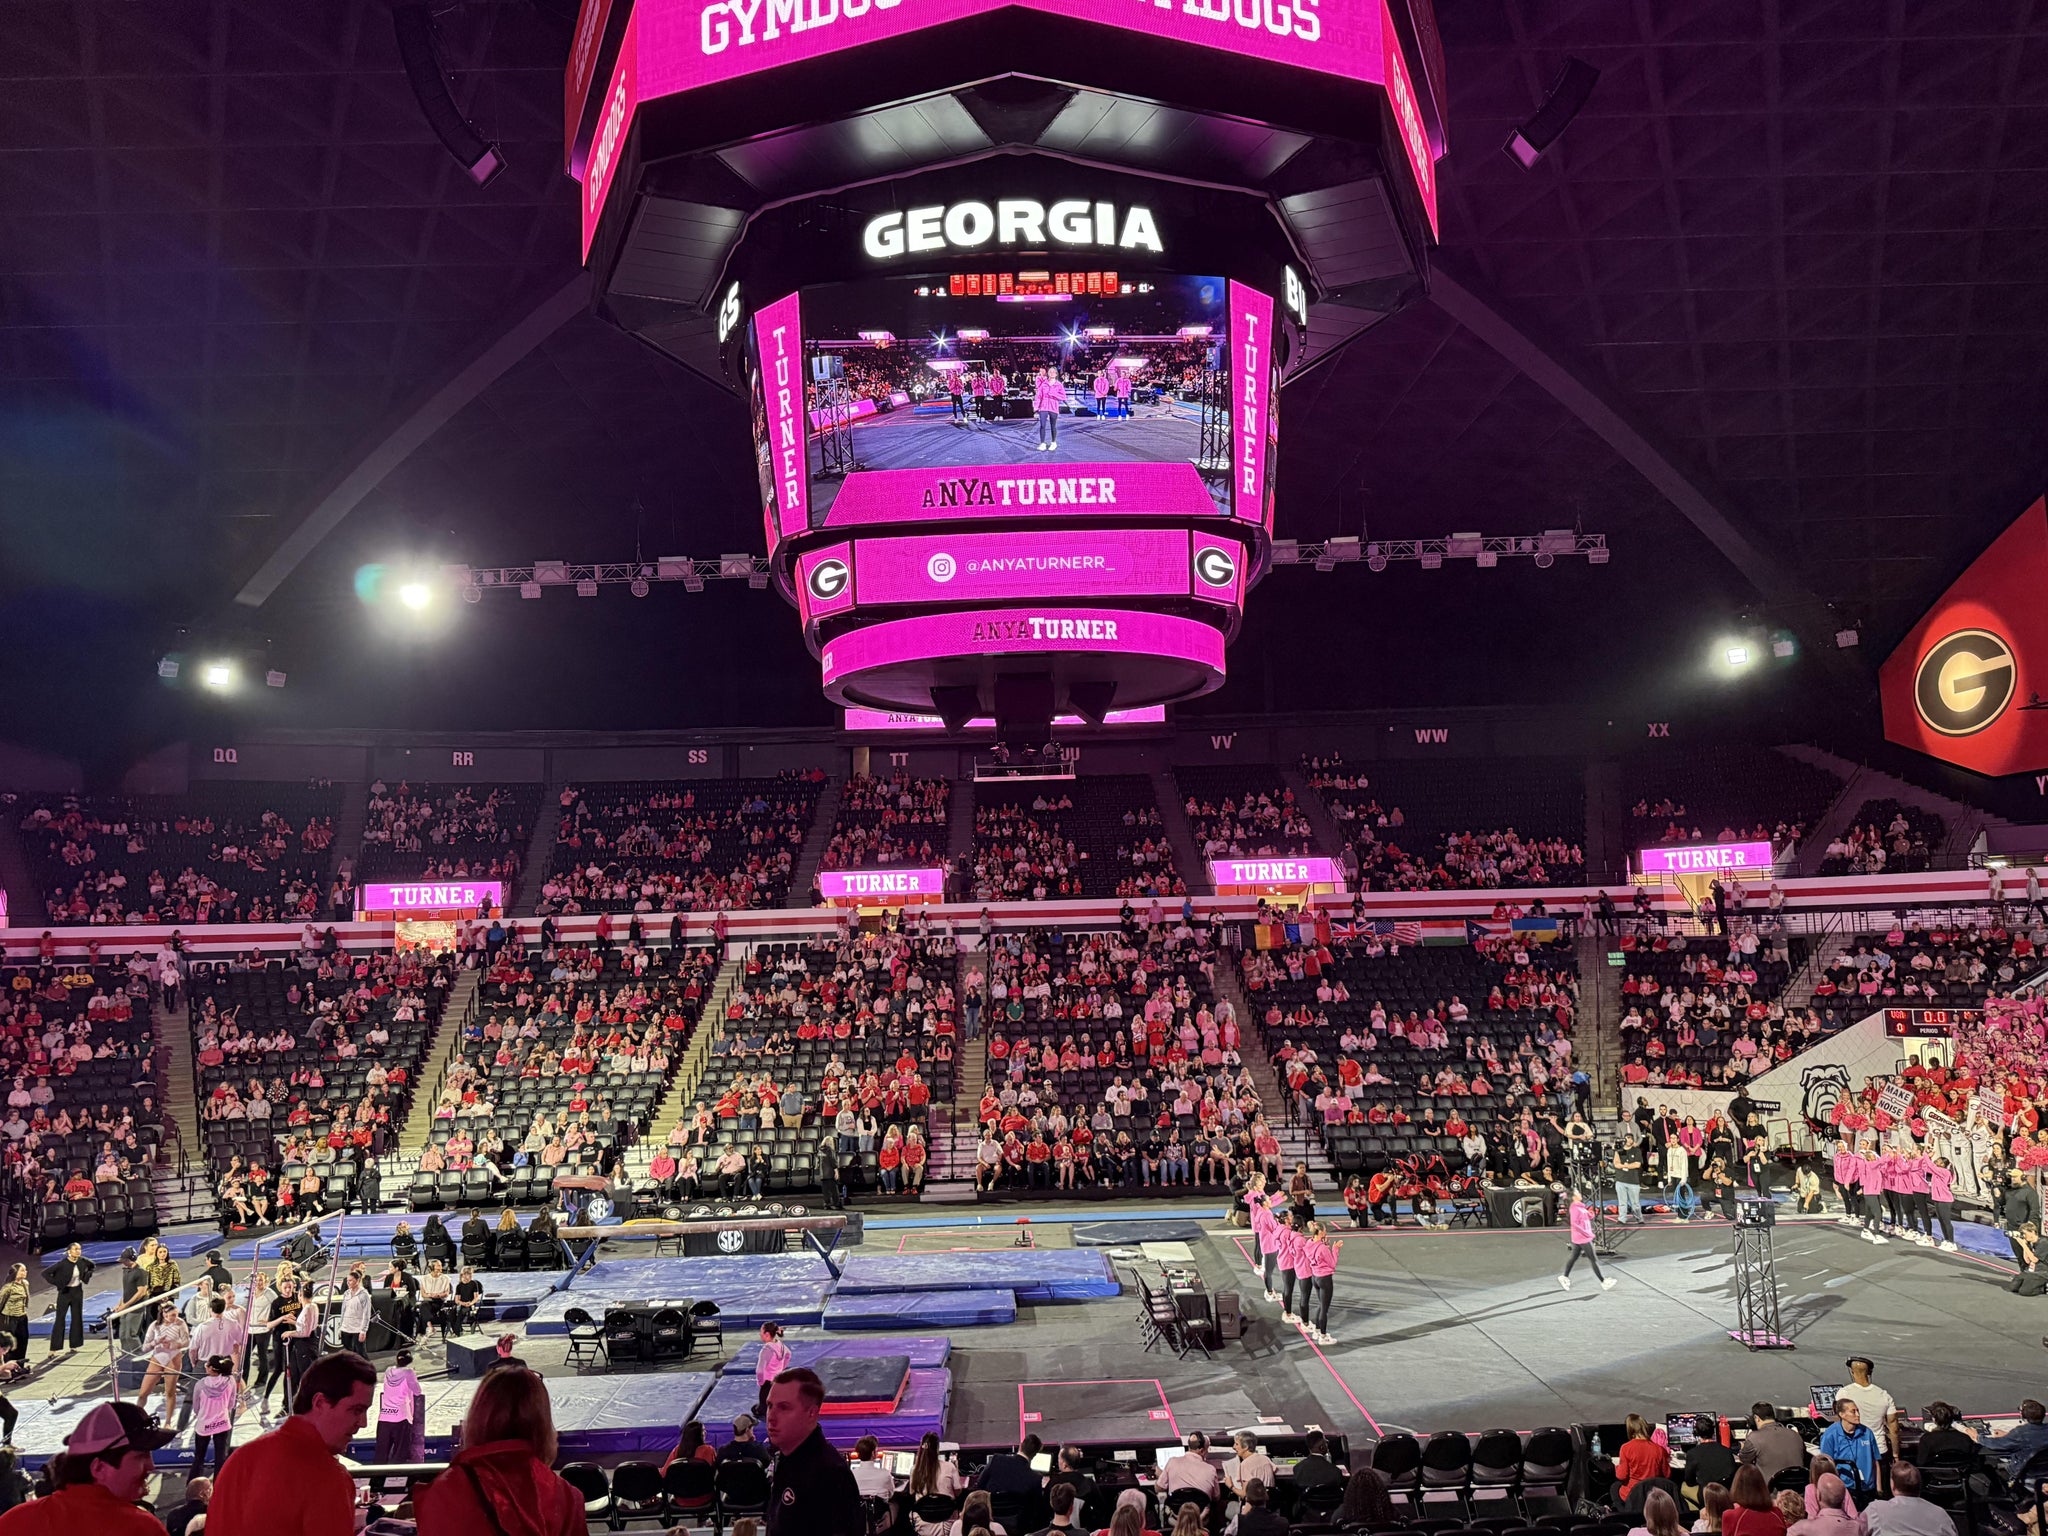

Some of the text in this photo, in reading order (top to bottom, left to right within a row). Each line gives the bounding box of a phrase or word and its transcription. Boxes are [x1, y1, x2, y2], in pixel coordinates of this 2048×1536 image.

[863, 200, 1164, 258] GEORGIA
[1242, 312, 1259, 497] TURNER
[772, 325, 800, 510] TURNER
[996, 477, 1117, 506] TURNER
[965, 555, 1116, 575] @ANYATURNERR_
[1028, 616, 1118, 641] TURNER
[888, 712, 916, 723] ANYA
[1415, 729, 1448, 744] WW
[1648, 723, 1670, 738] XX
[1211, 735, 1233, 750] VV
[452, 752, 474, 766] RR
[688, 750, 708, 764] SS
[889, 752, 909, 767] TT
[2035, 775, 2048, 795] Y
[1663, 849, 1746, 869] TURNER
[1231, 862, 1309, 881] TURNER
[842, 873, 920, 893] TURNER
[389, 886, 475, 906] TURNER
[1923, 1011, 1947, 1023] 0.0
[1885, 1084, 1911, 1102] MAKE
[1878, 1100, 1904, 1117] NOISE
[1928, 1111, 1957, 1128] GEORGIA
[590, 1202, 609, 1218] SEC
[719, 1230, 742, 1251] SEC
